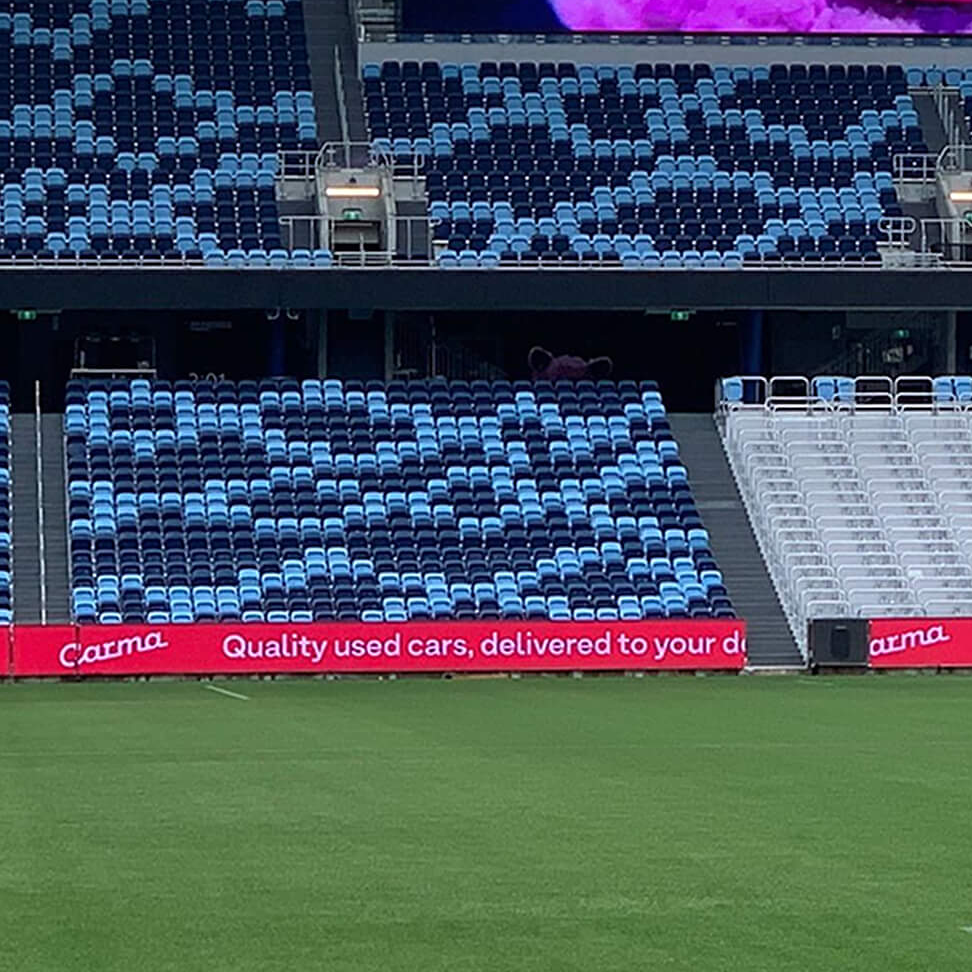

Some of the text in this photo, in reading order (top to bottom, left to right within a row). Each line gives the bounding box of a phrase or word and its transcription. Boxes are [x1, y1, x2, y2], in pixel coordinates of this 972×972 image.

[59, 631, 168, 667] Carma
[223, 633, 327, 662] Quality
[334, 633, 400, 656] used
[408, 638, 474, 658] cars,
[481, 632, 611, 656] delivered
[617, 633, 647, 655] to
[654, 637, 716, 660] your
[869, 624, 950, 657] arma
